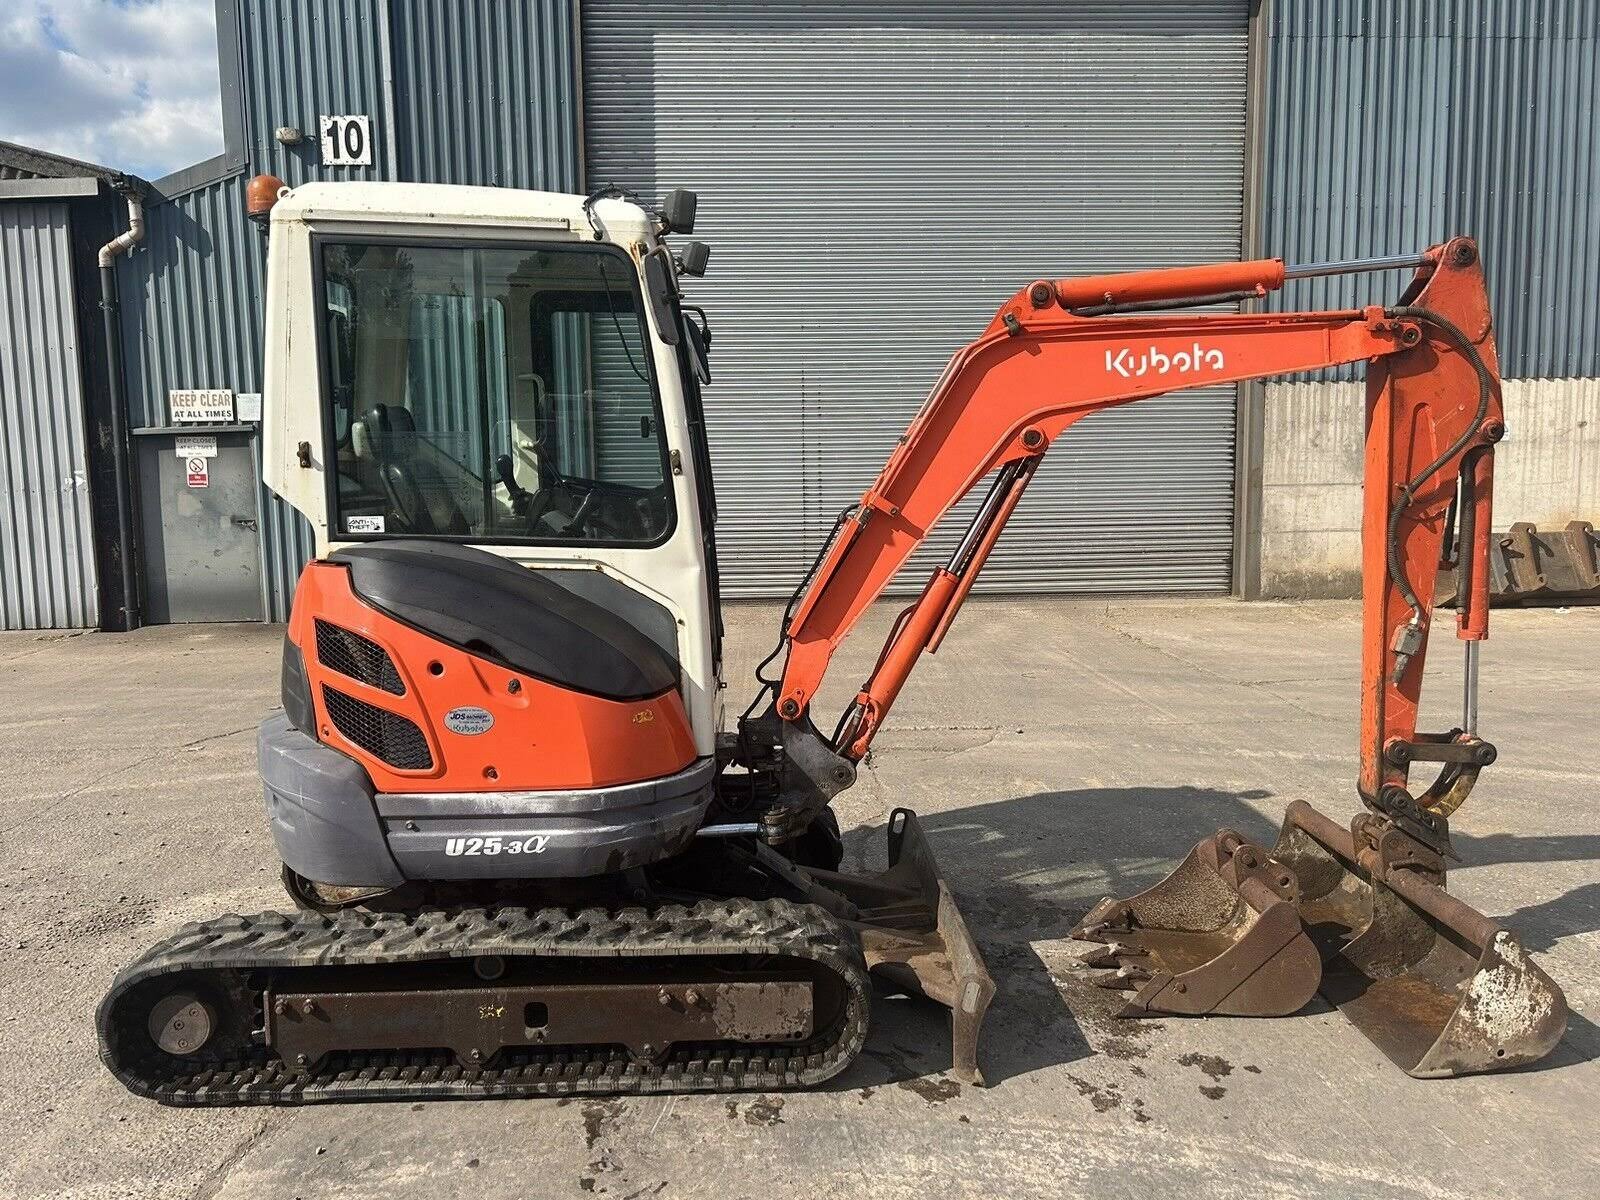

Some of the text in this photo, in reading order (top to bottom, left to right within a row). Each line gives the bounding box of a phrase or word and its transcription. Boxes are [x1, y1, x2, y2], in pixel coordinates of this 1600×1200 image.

[327, 120, 364, 159] 10
[1105, 342, 1224, 378] Kubota
[172, 393, 231, 407] KEEP CLEAR
